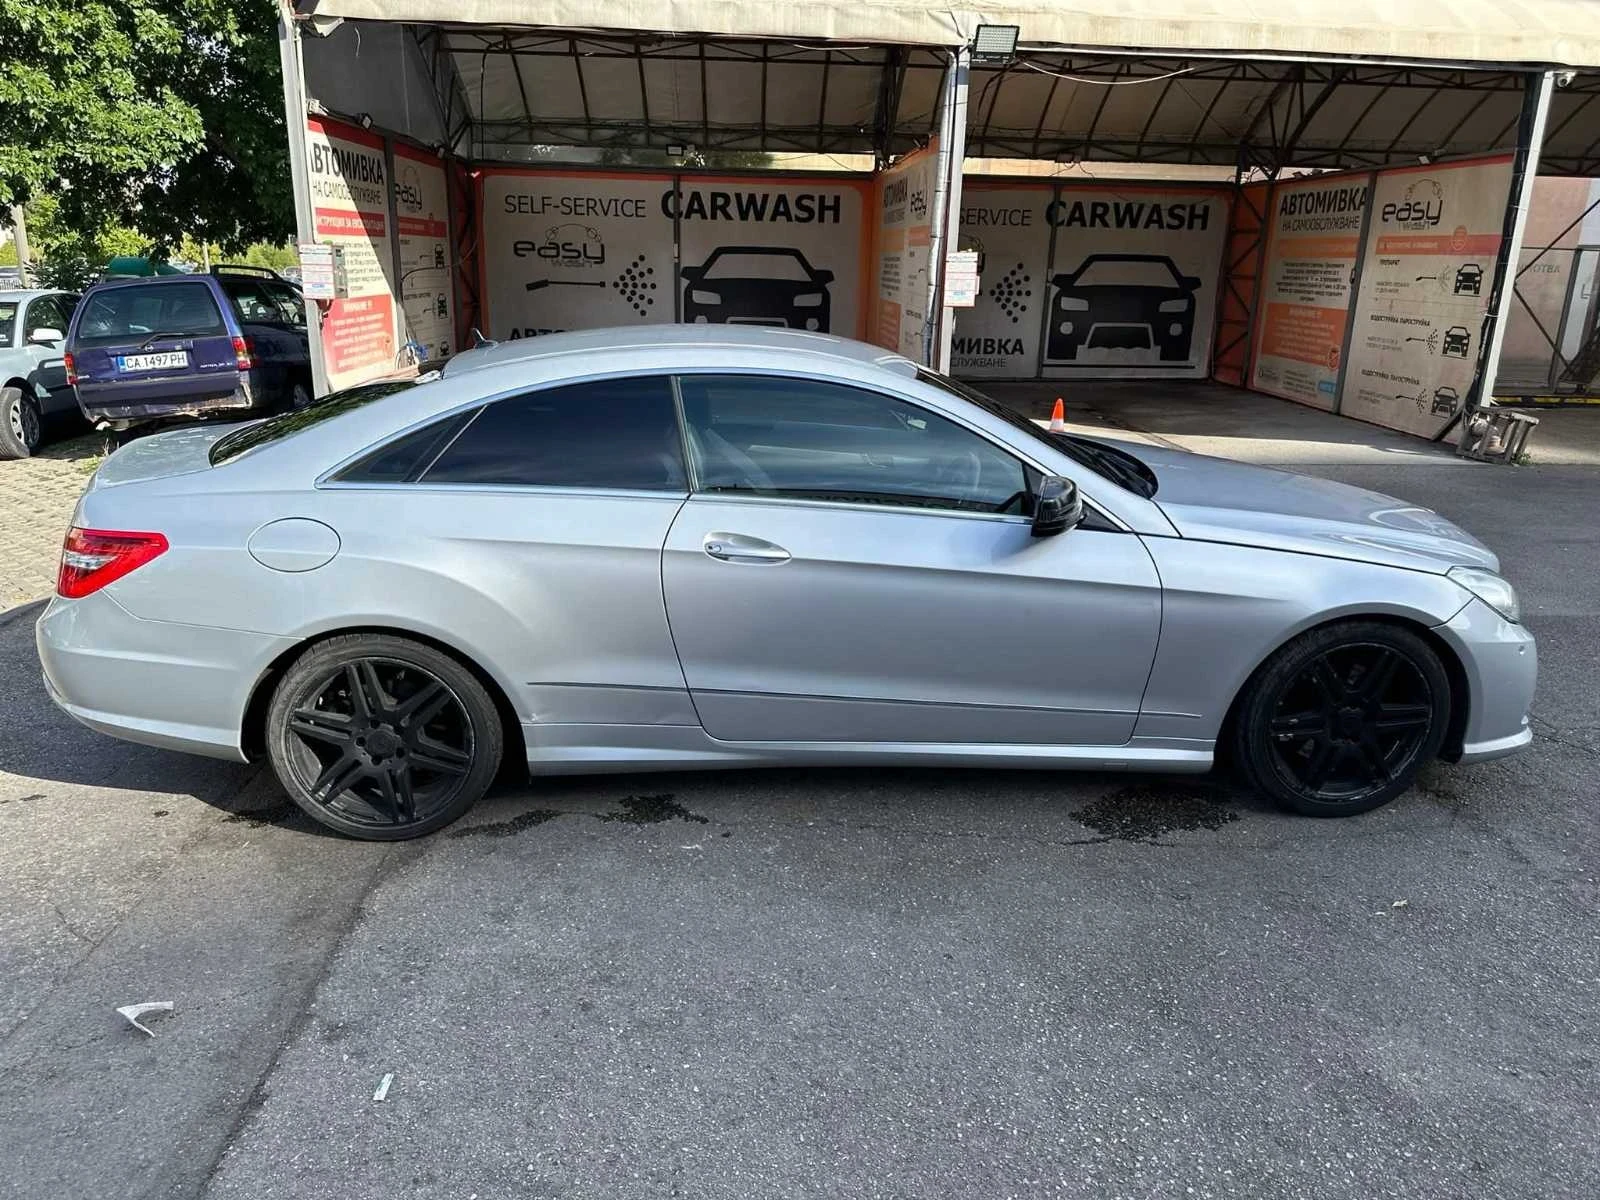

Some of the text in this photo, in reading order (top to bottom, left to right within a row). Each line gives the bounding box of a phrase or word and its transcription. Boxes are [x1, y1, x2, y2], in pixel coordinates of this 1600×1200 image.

[504, 194, 647, 218] SELF-SERVICE
[660, 189, 842, 224] CARWASH
[1280, 186, 1369, 216] АВТОМИВКА
[1382, 199, 1443, 225] easy
[1046, 200, 1210, 231] CARWASH
[513, 240, 605, 265] easy
[126, 353, 185, 369] CA 1497 PH
